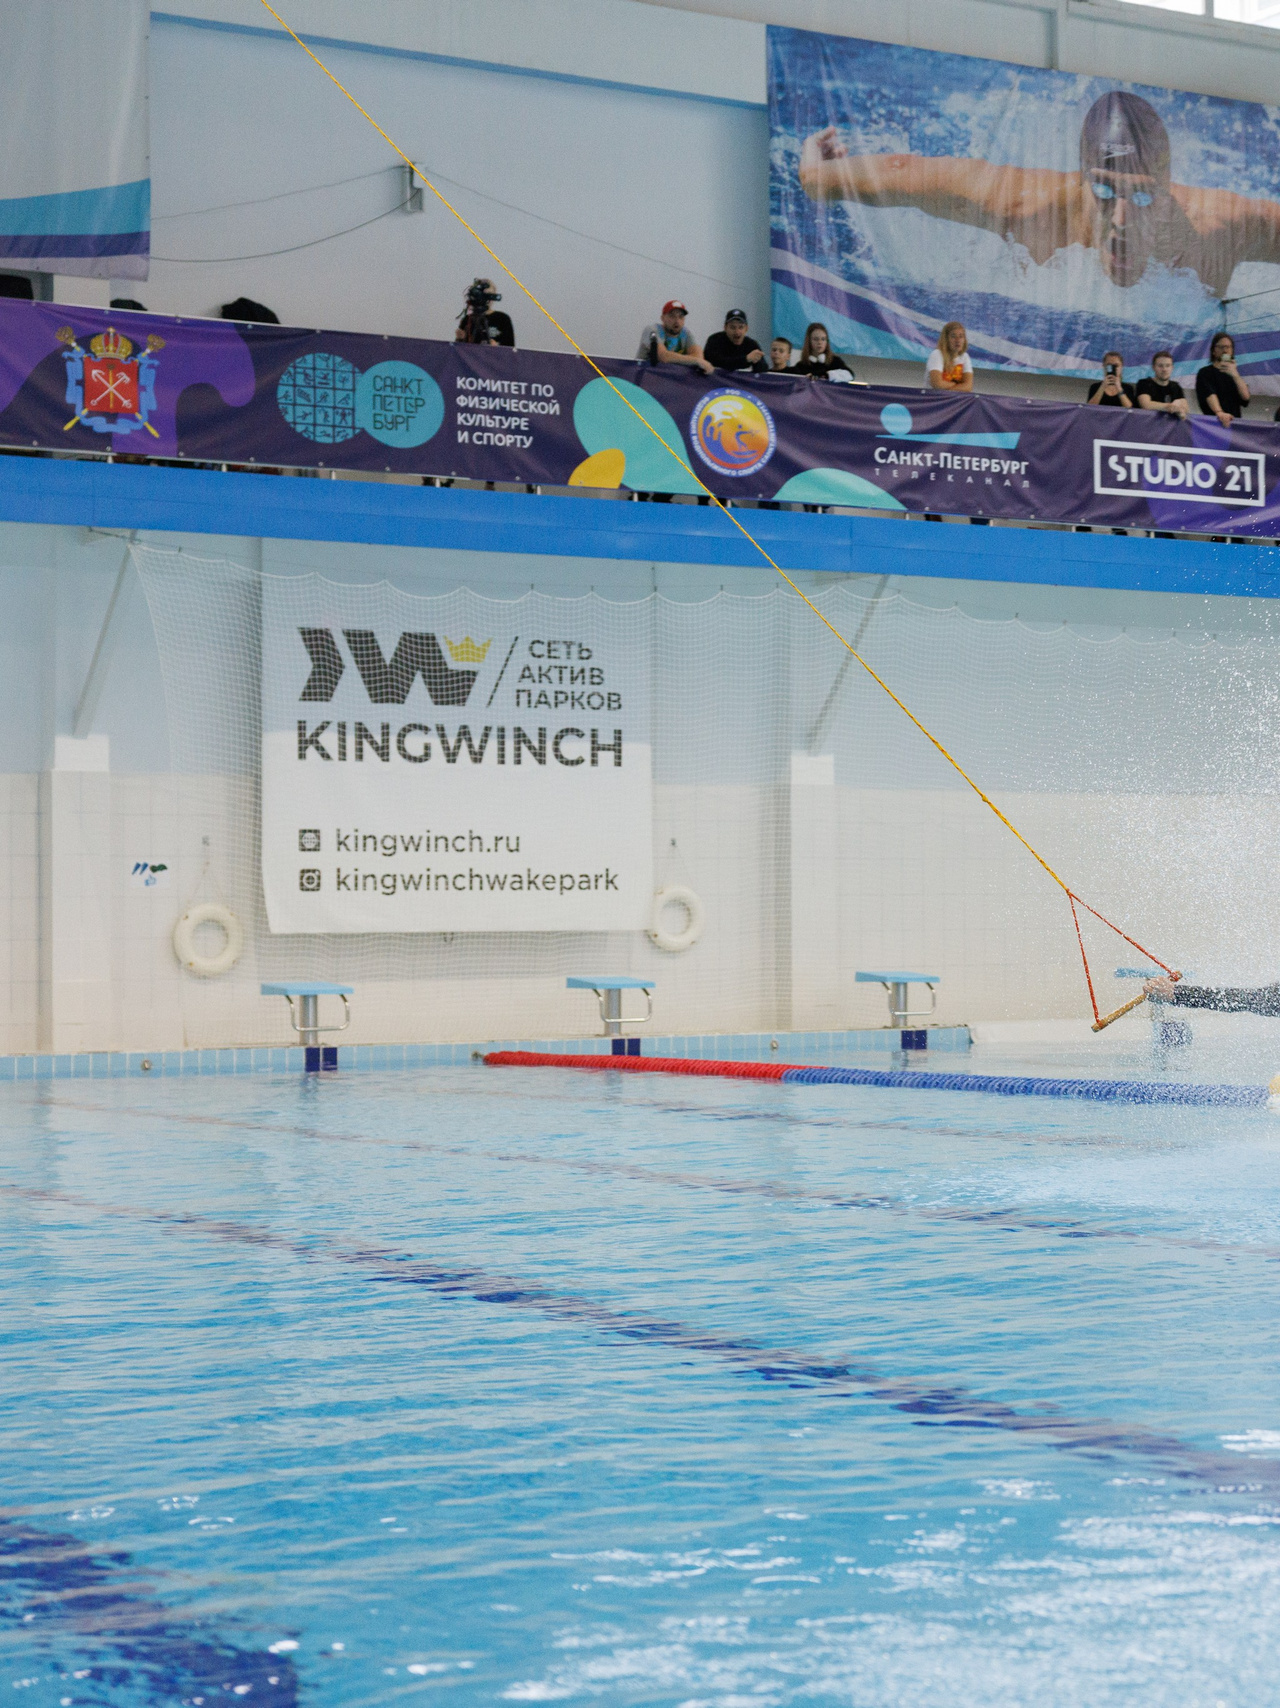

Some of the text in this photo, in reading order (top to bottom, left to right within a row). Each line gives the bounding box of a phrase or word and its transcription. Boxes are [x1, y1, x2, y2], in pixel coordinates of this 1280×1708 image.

[373, 375, 423, 394] САНКТ
[456, 376, 554, 397] КОМИТЕТ ПО
[373, 393, 425, 413] ПЕТЕР
[456, 394, 560, 415] ФИЗИЧЕСКОЙ
[373, 413, 415, 432] БУРГ
[457, 412, 529, 430] КУЛЬТУРЕ
[457, 431, 533, 448] И СПОРТУ
[875, 468, 1030, 488] ТЕЛЕКАНАЛ
[1108, 454, 1252, 492] STUDIO 21
[528, 639, 593, 660] СЕТЬ
[518, 664, 605, 686] АКТИВ
[515, 688, 622, 711] ПАРКОВ
[297, 720, 623, 767] KINGWINCH
[336, 828, 520, 857] kingwinch.ru
[336, 867, 620, 896] kingwinchwakepark
